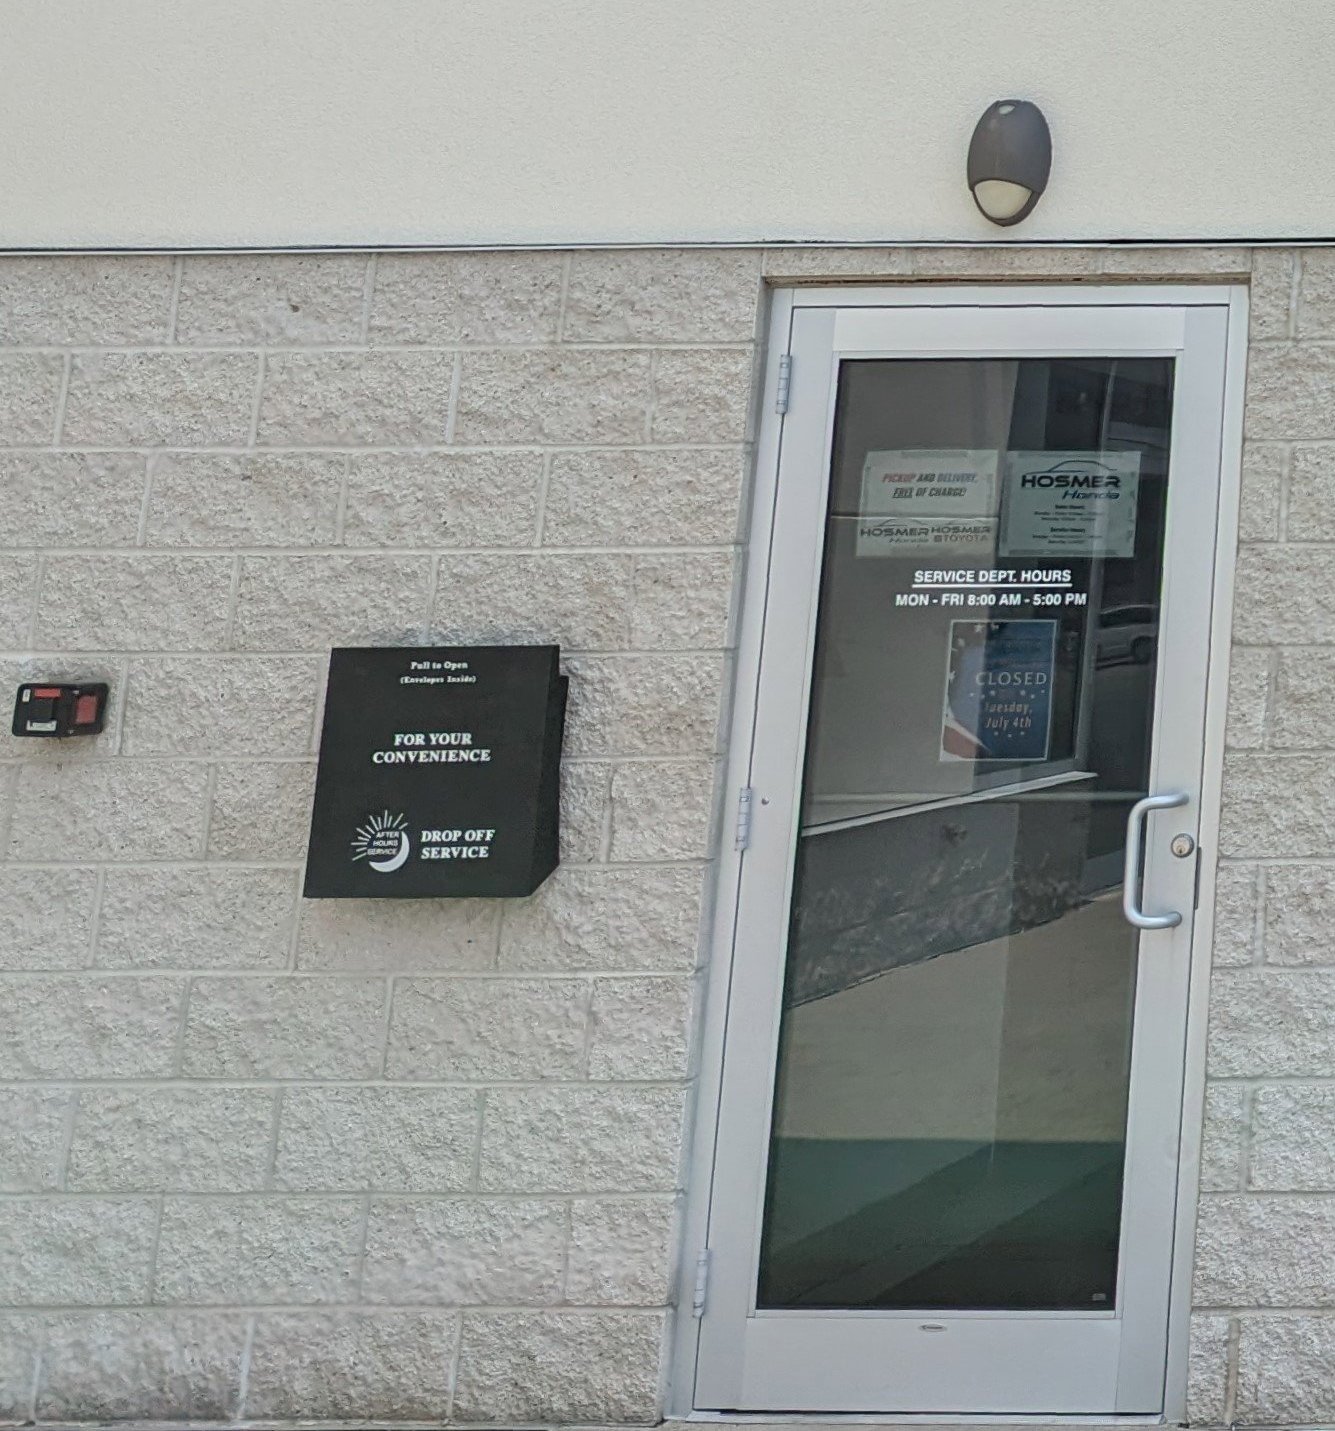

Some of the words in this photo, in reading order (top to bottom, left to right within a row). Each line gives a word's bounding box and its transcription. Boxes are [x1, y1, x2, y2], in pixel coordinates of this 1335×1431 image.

[881, 473, 916, 483] PICKUP
[917, 473, 936, 483] AND
[1021, 475, 1121, 488] HOSMER
[893, 487, 913, 497] FREE
[916, 487, 928, 497] OF
[1062, 490, 1120, 500] Honda
[860, 527, 930, 537] HOSMER
[931, 526, 991, 534] HOSMER
[944, 535, 988, 543] TOYOTA
[914, 570, 975, 583] SERVICE
[978, 570, 1017, 582] DEPT.
[1021, 569, 1072, 582] HOURS
[895, 594, 930, 606] MON
[941, 594, 964, 606] FRI
[967, 594, 996, 605] 8:00
[998, 593, 1022, 605] AM
[1032, 593, 1062, 605] 5:00
[1065, 593, 1087, 605] PM
[410, 661, 431, 670] Pull
[432, 661, 442, 669] to
[443, 661, 468, 671] Open
[400, 675, 444, 684] (Envelopes
[447, 675, 476, 683] Inside)
[975, 671, 1047, 686] CLOSED
[985, 717, 1010, 731] July
[1013, 717, 1032, 728] 4th
[394, 733, 426, 746] FOR
[429, 732, 472, 745] YOUR
[372, 749, 491, 764] CONVENIENCE
[375, 831, 400, 839] AFTER
[421, 829, 461, 843] DROP
[464, 829, 496, 842] OFF
[373, 839, 399, 847] HOURS
[367, 848, 398, 856] SERVICE
[420, 845, 489, 859] SERVICE
